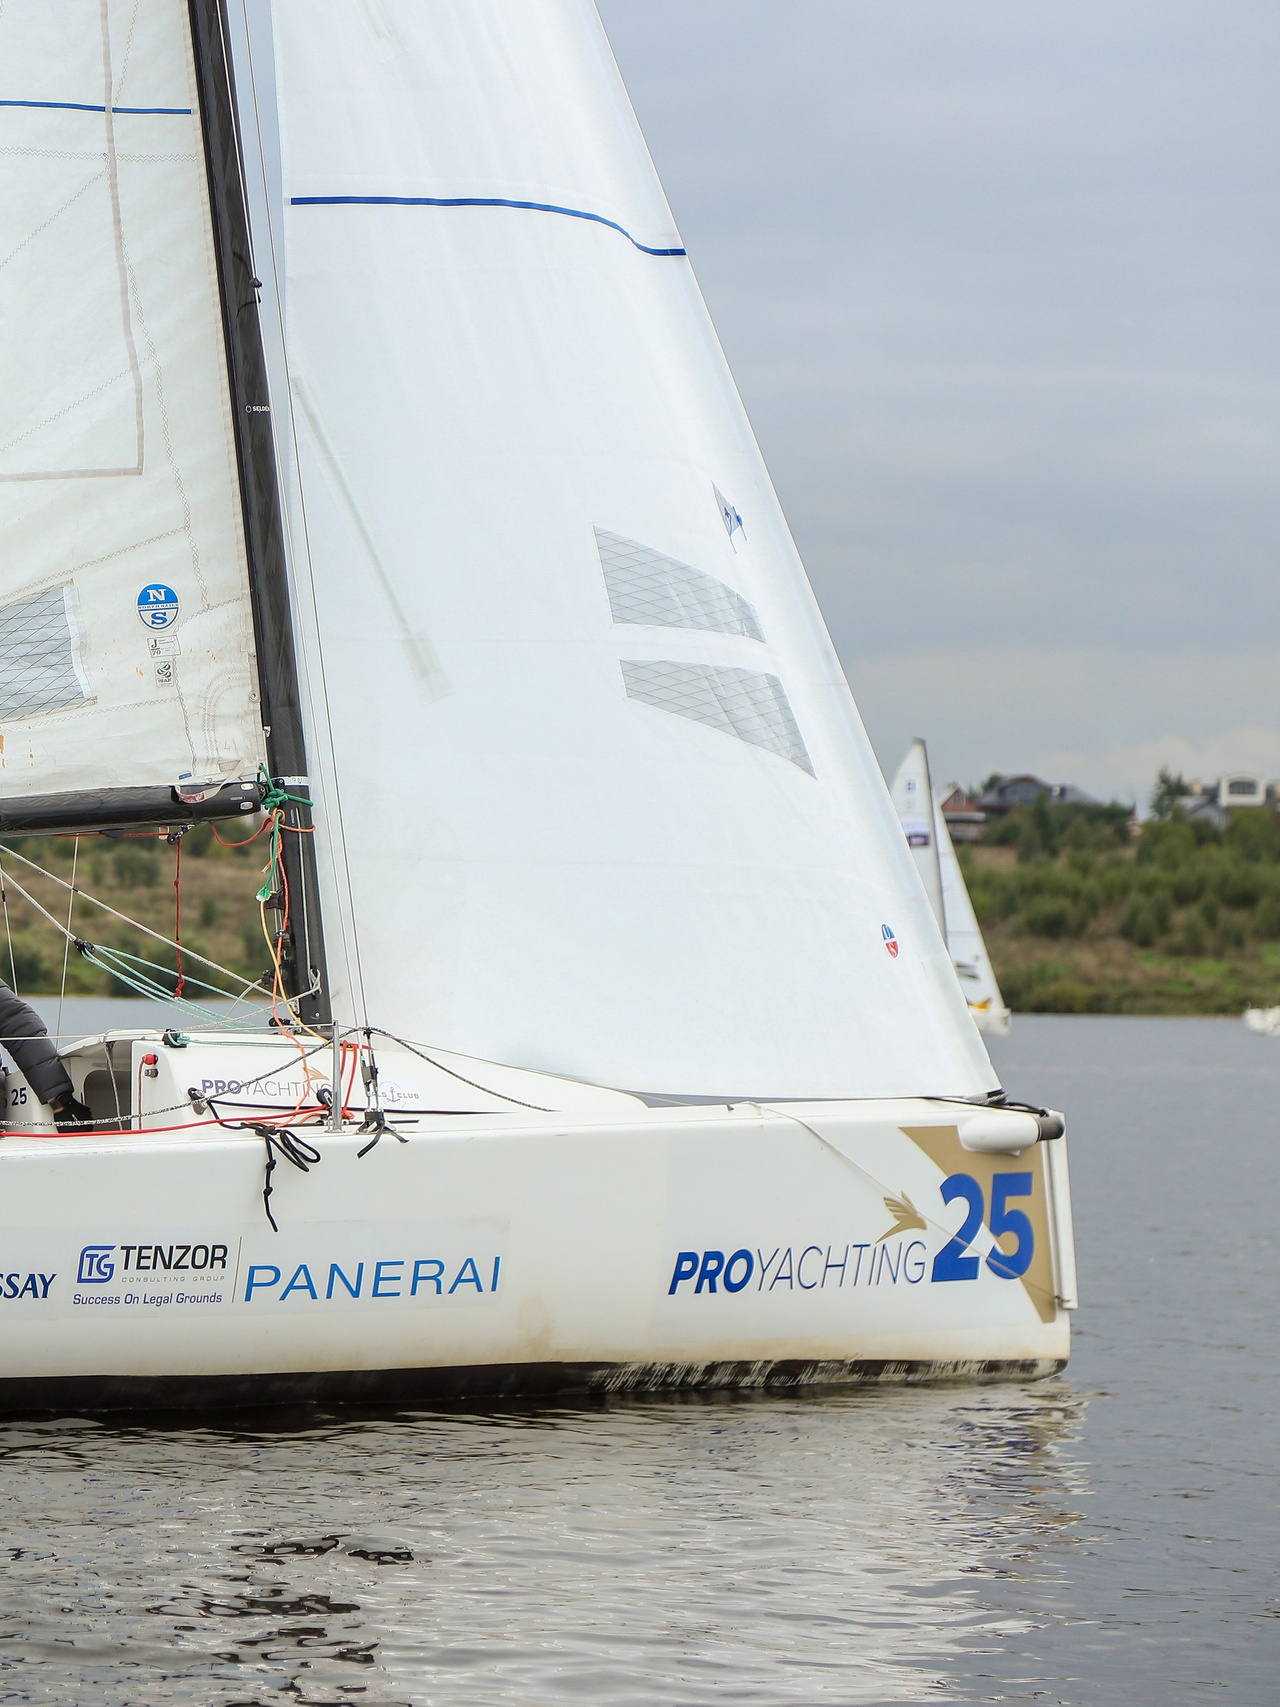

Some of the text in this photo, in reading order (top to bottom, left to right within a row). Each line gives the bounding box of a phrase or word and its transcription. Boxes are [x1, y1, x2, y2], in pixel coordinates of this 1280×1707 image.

[147, 589, 166, 601] N
[151, 612, 167, 625] S
[11, 1087, 27, 1106] 25
[930, 1172, 1035, 1283] 25
[120, 1244, 228, 1270] TENZOR
[667, 1240, 927, 1295] PROYACHTING
[244, 1255, 501, 1302] PANERAI
[73, 1292, 222, 1307] Success On Legal Grounds
